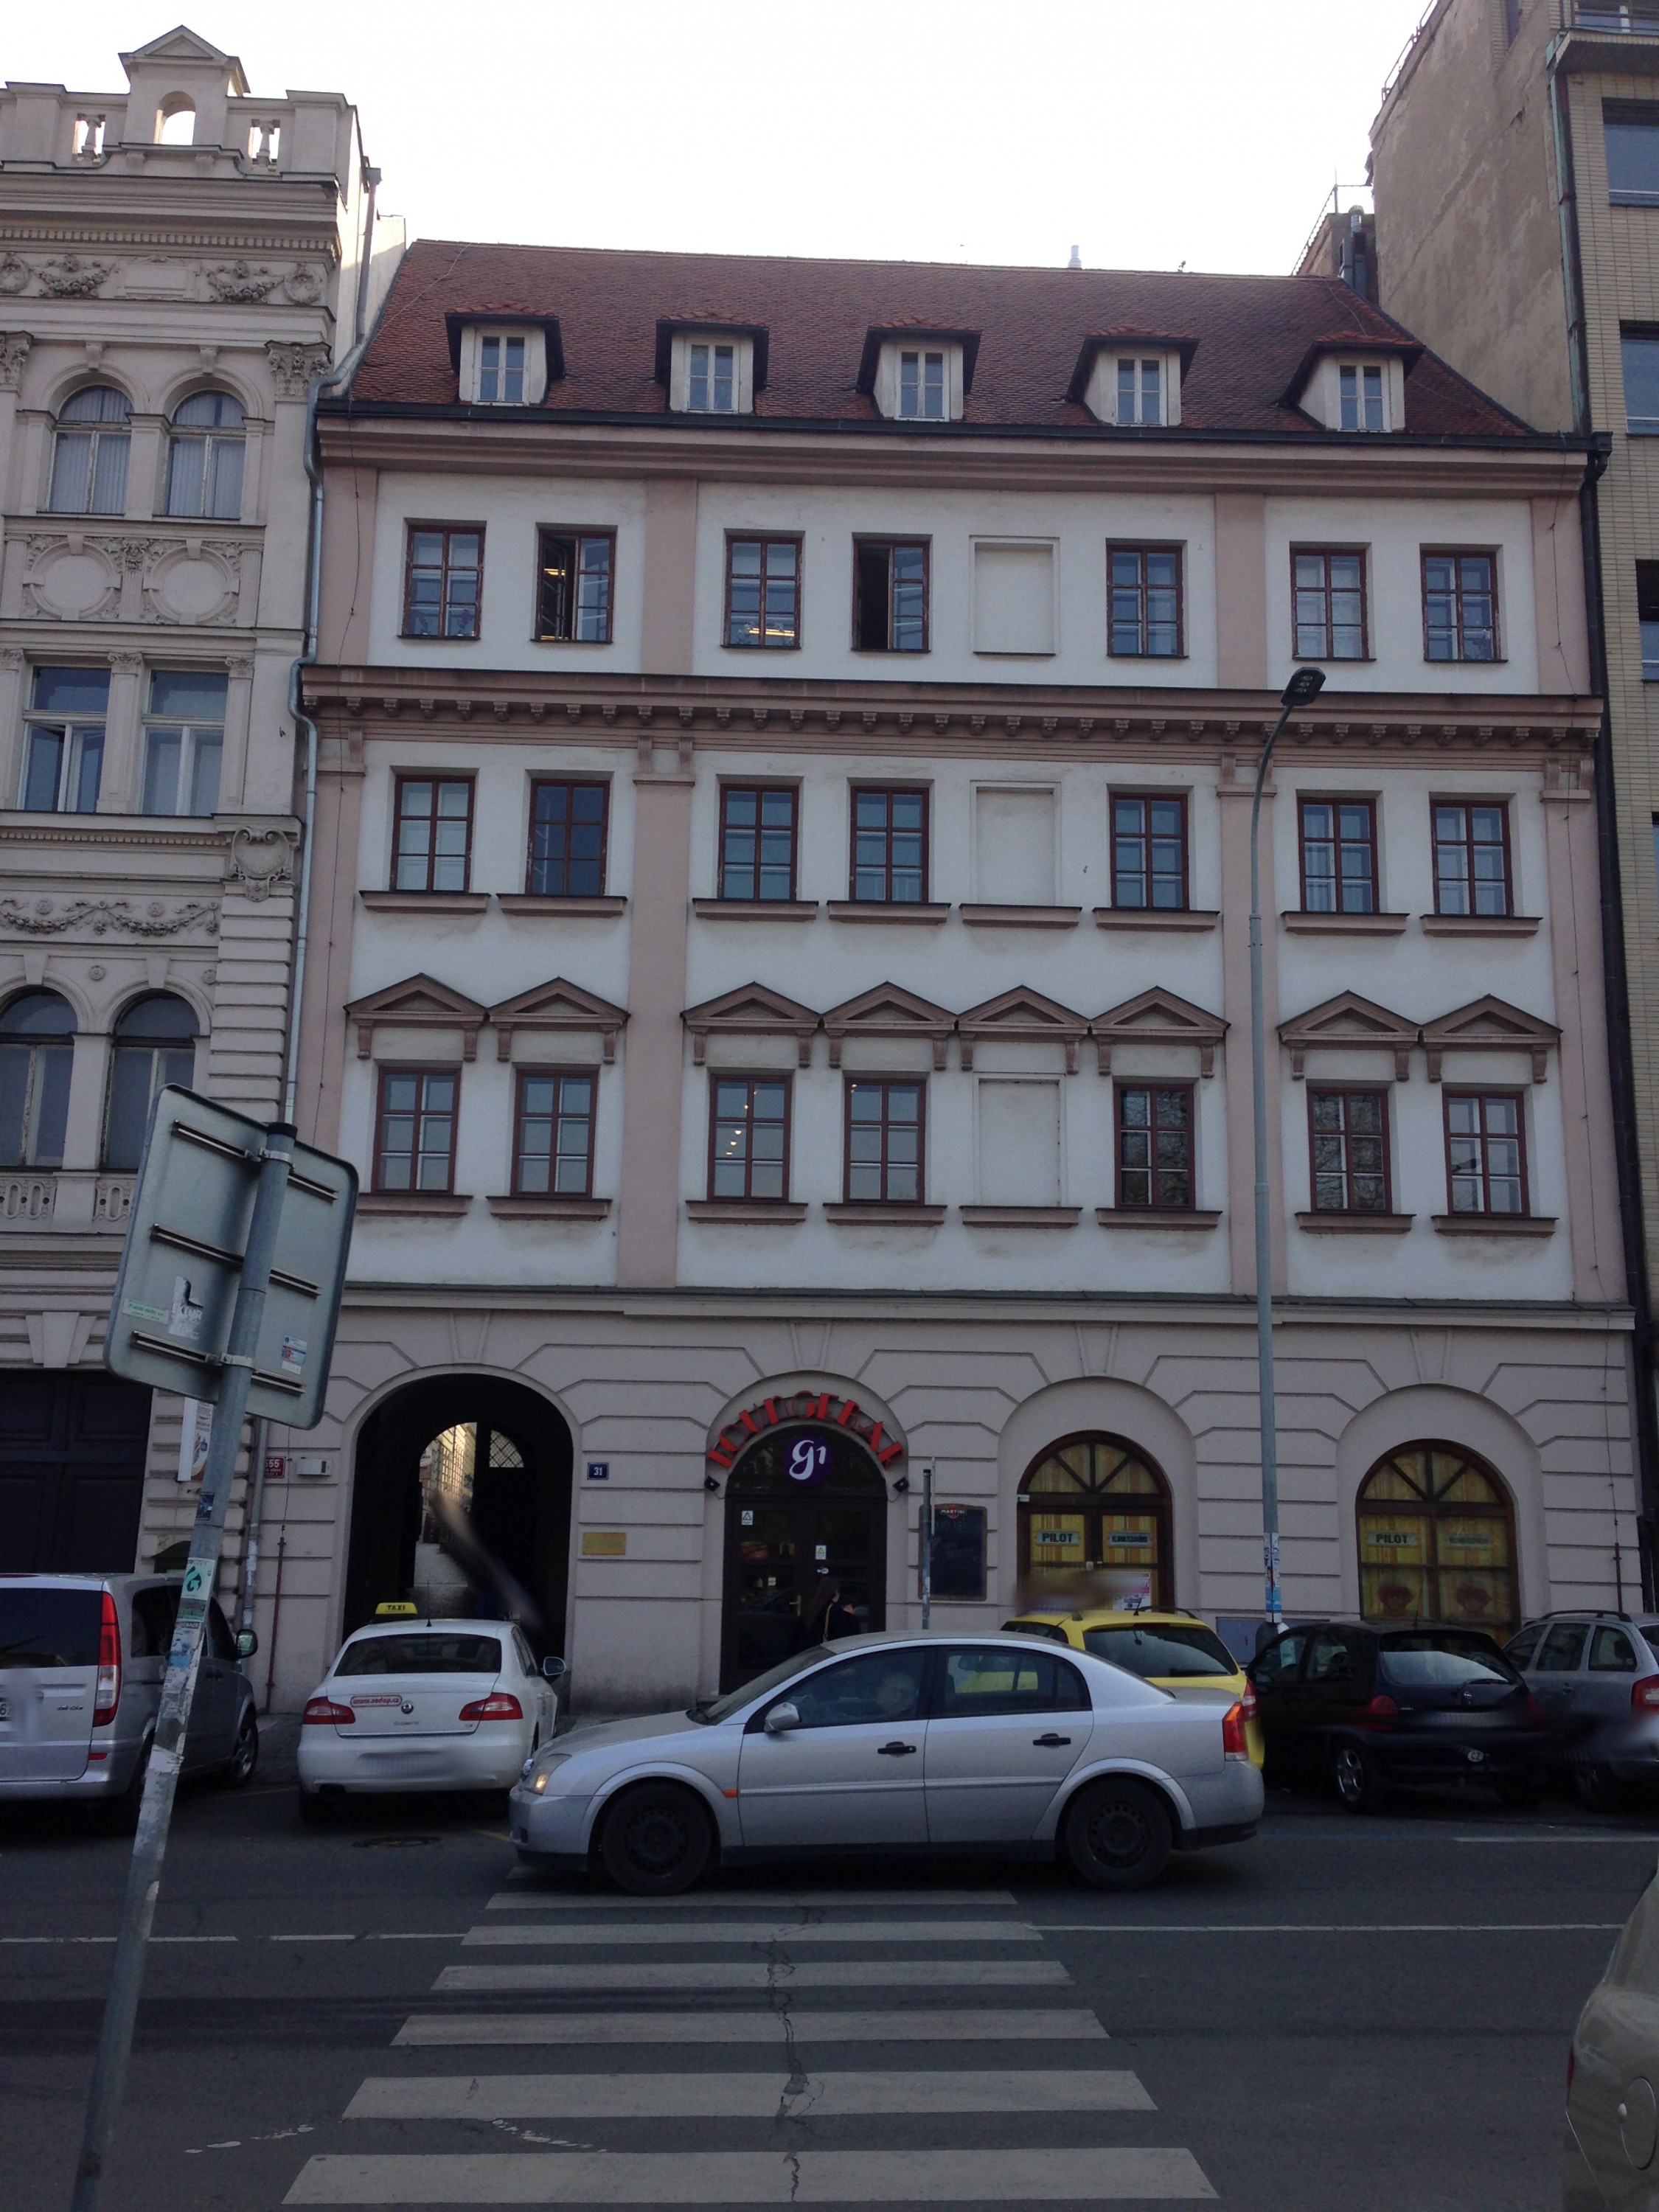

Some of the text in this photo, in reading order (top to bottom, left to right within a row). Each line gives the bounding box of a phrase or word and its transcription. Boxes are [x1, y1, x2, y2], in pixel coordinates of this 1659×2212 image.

[594, 1467, 603, 1476] 31
[1042, 1533, 1073, 1543] PILOT
[1376, 1534, 1408, 1544] PILOT
